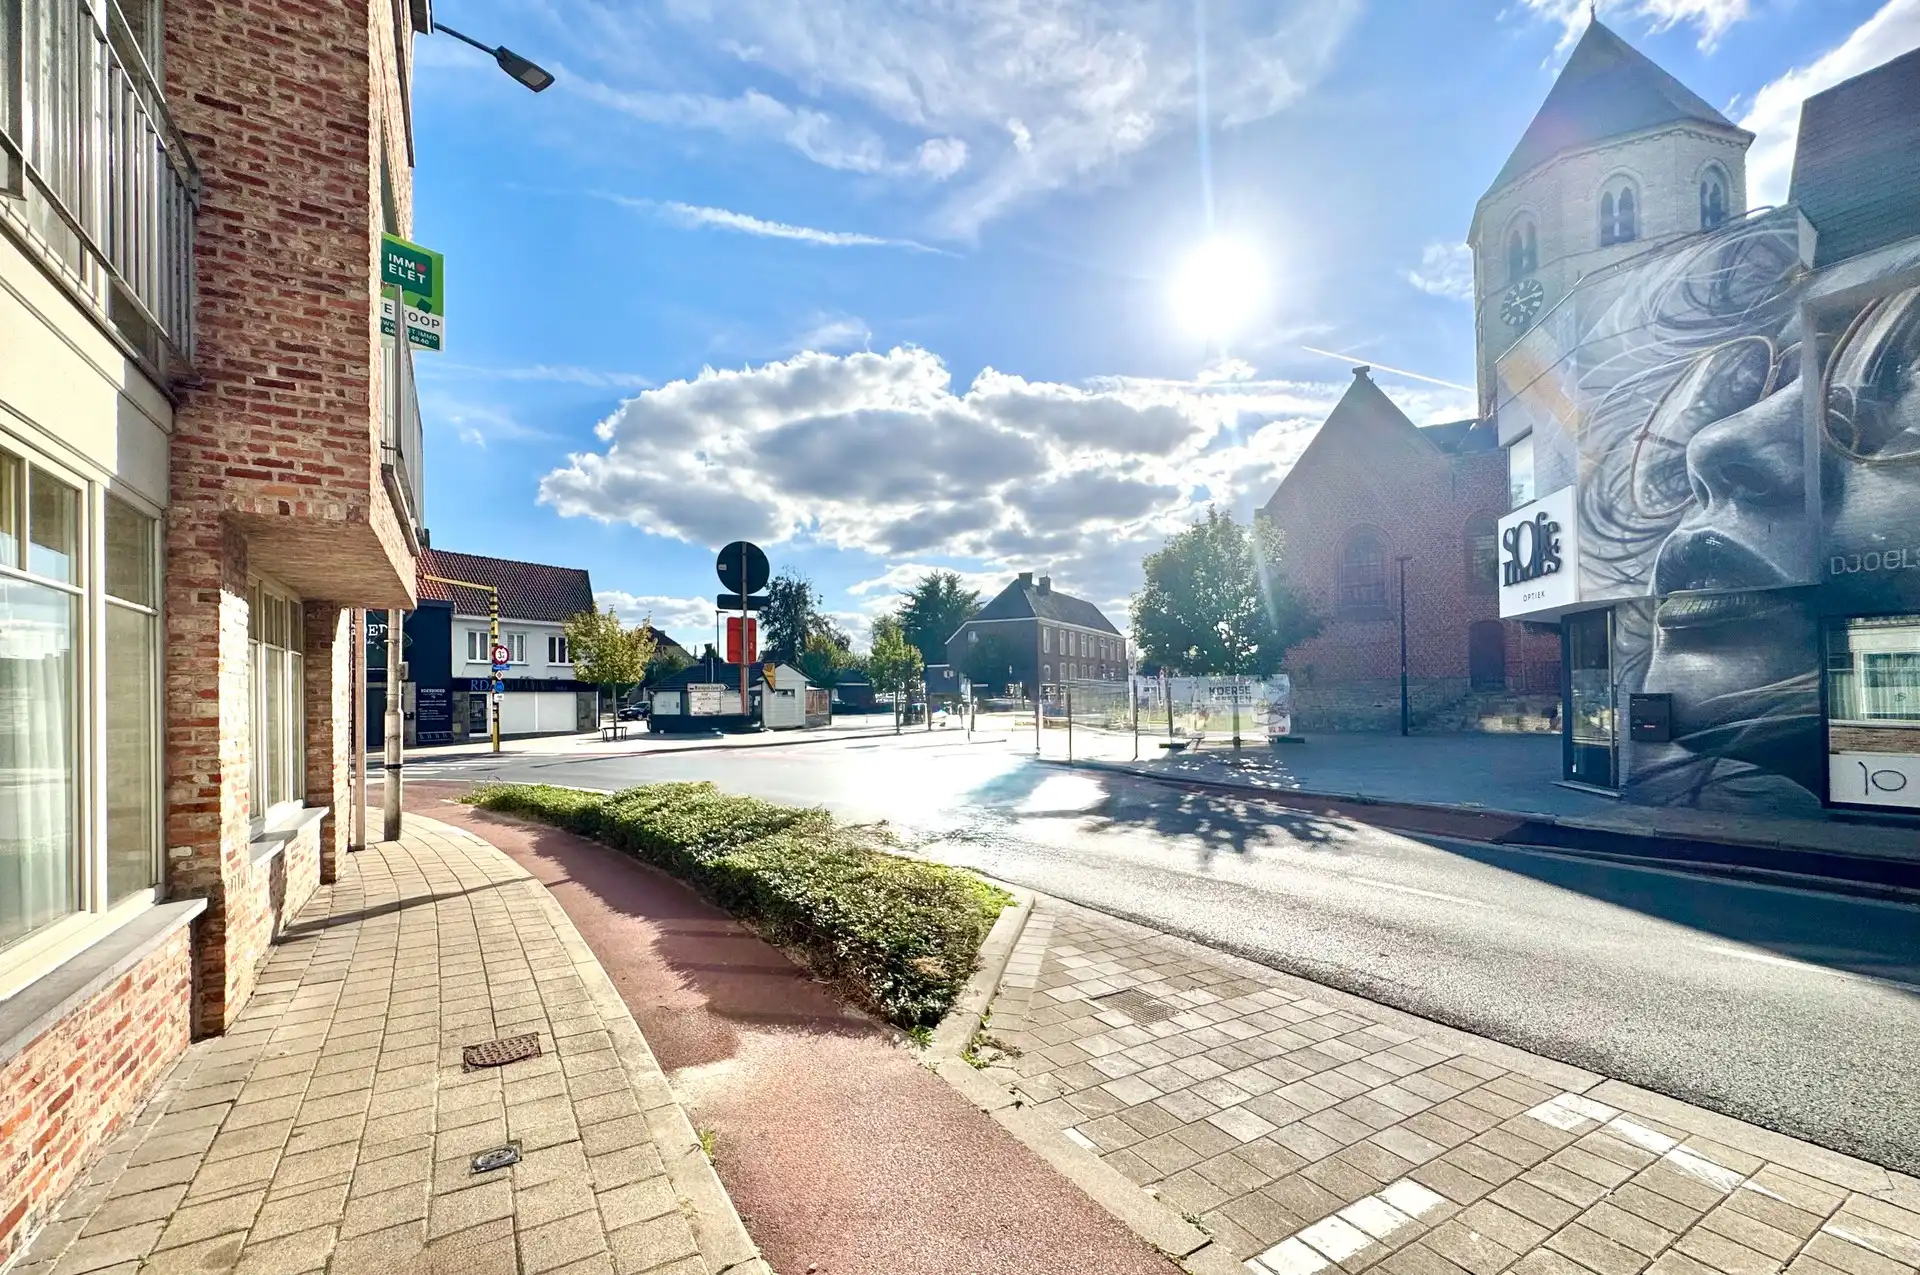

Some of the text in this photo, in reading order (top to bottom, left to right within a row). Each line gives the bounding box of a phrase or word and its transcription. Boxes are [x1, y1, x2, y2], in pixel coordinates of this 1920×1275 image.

[389, 263, 427, 285] ELET
[404, 309, 440, 329] OOP
[1523, 591, 1546, 602] OPTIEK
[1209, 686, 1251, 695] KOERSE
[1858, 761, 1907, 796] 10
